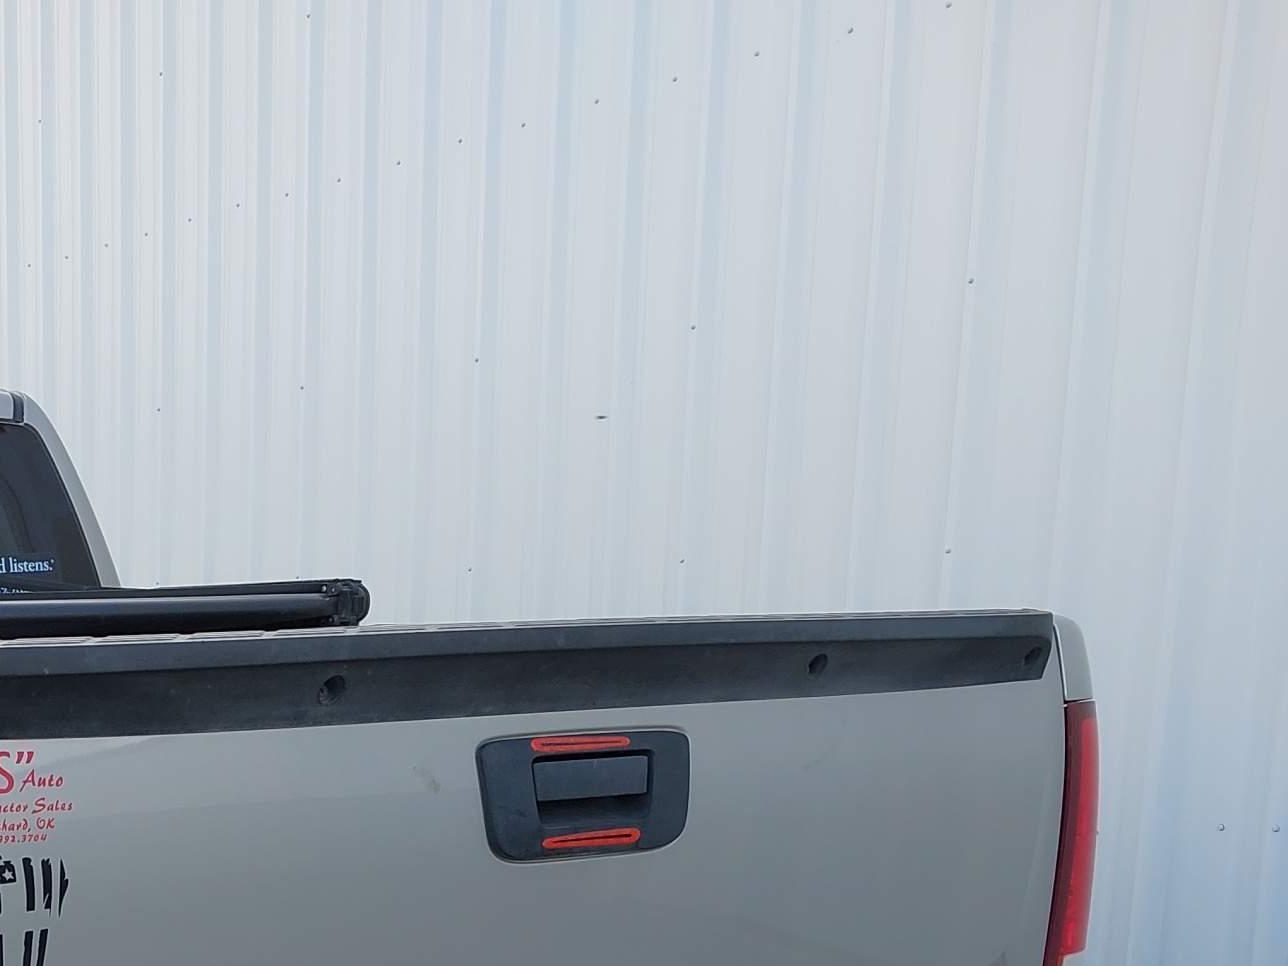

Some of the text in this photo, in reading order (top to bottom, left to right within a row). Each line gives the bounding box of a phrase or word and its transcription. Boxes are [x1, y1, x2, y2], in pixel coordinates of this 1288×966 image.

[19, 768, 64, 793] Auto
[31, 797, 73, 814] Sales
[36, 817, 55, 830] OK
